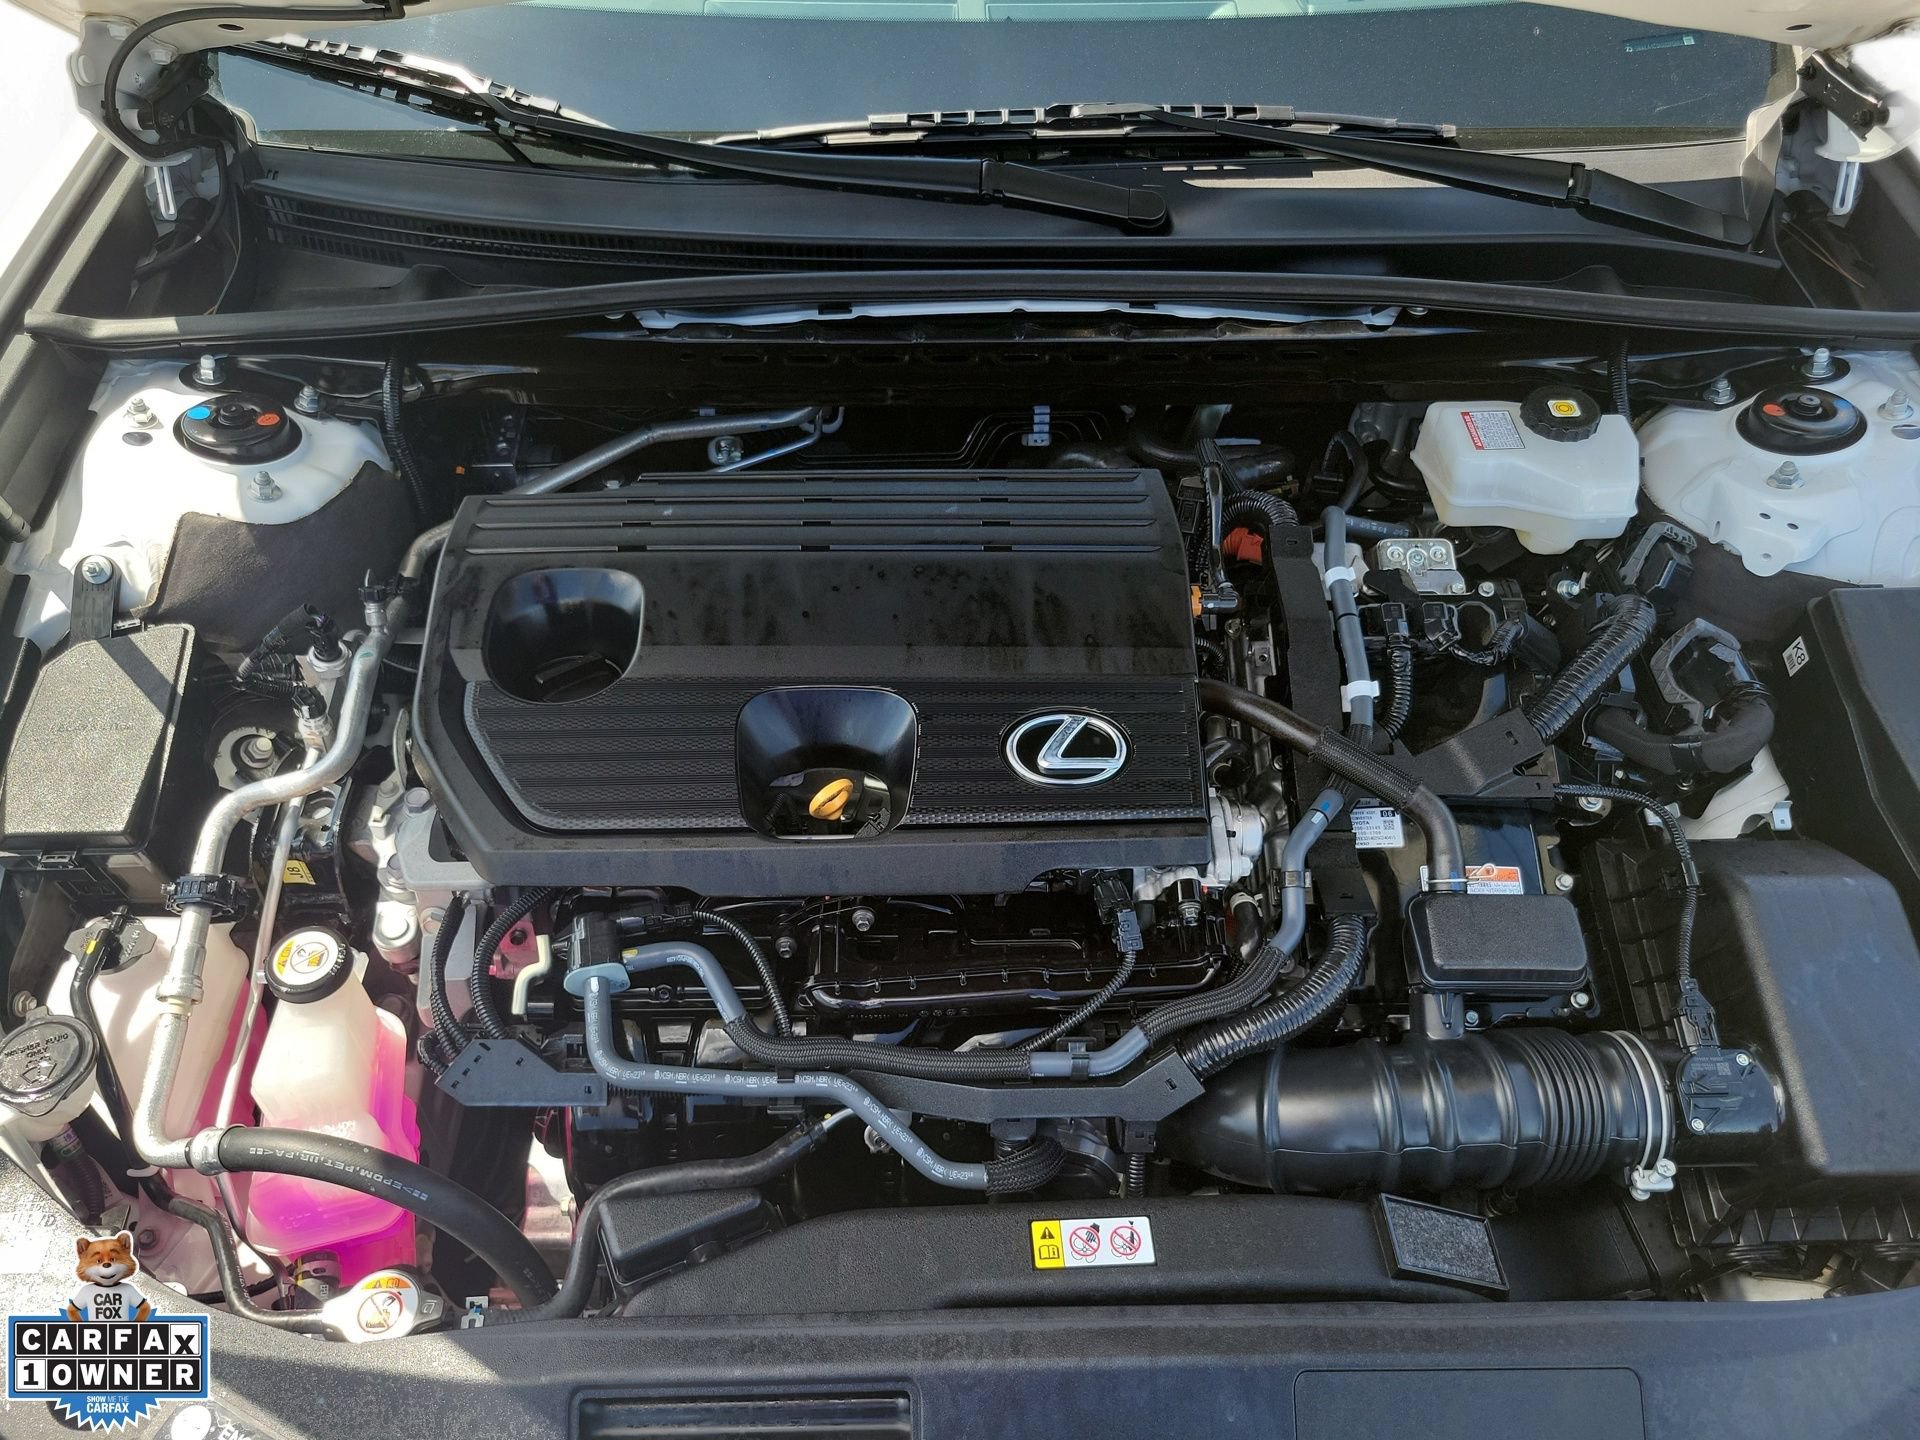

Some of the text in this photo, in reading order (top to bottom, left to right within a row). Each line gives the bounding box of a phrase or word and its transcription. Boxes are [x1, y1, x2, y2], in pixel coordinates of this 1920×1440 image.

[1792, 641, 1806, 665] K8
[287, 866, 304, 878] J8
[27, 1046, 49, 1058] ONLY
